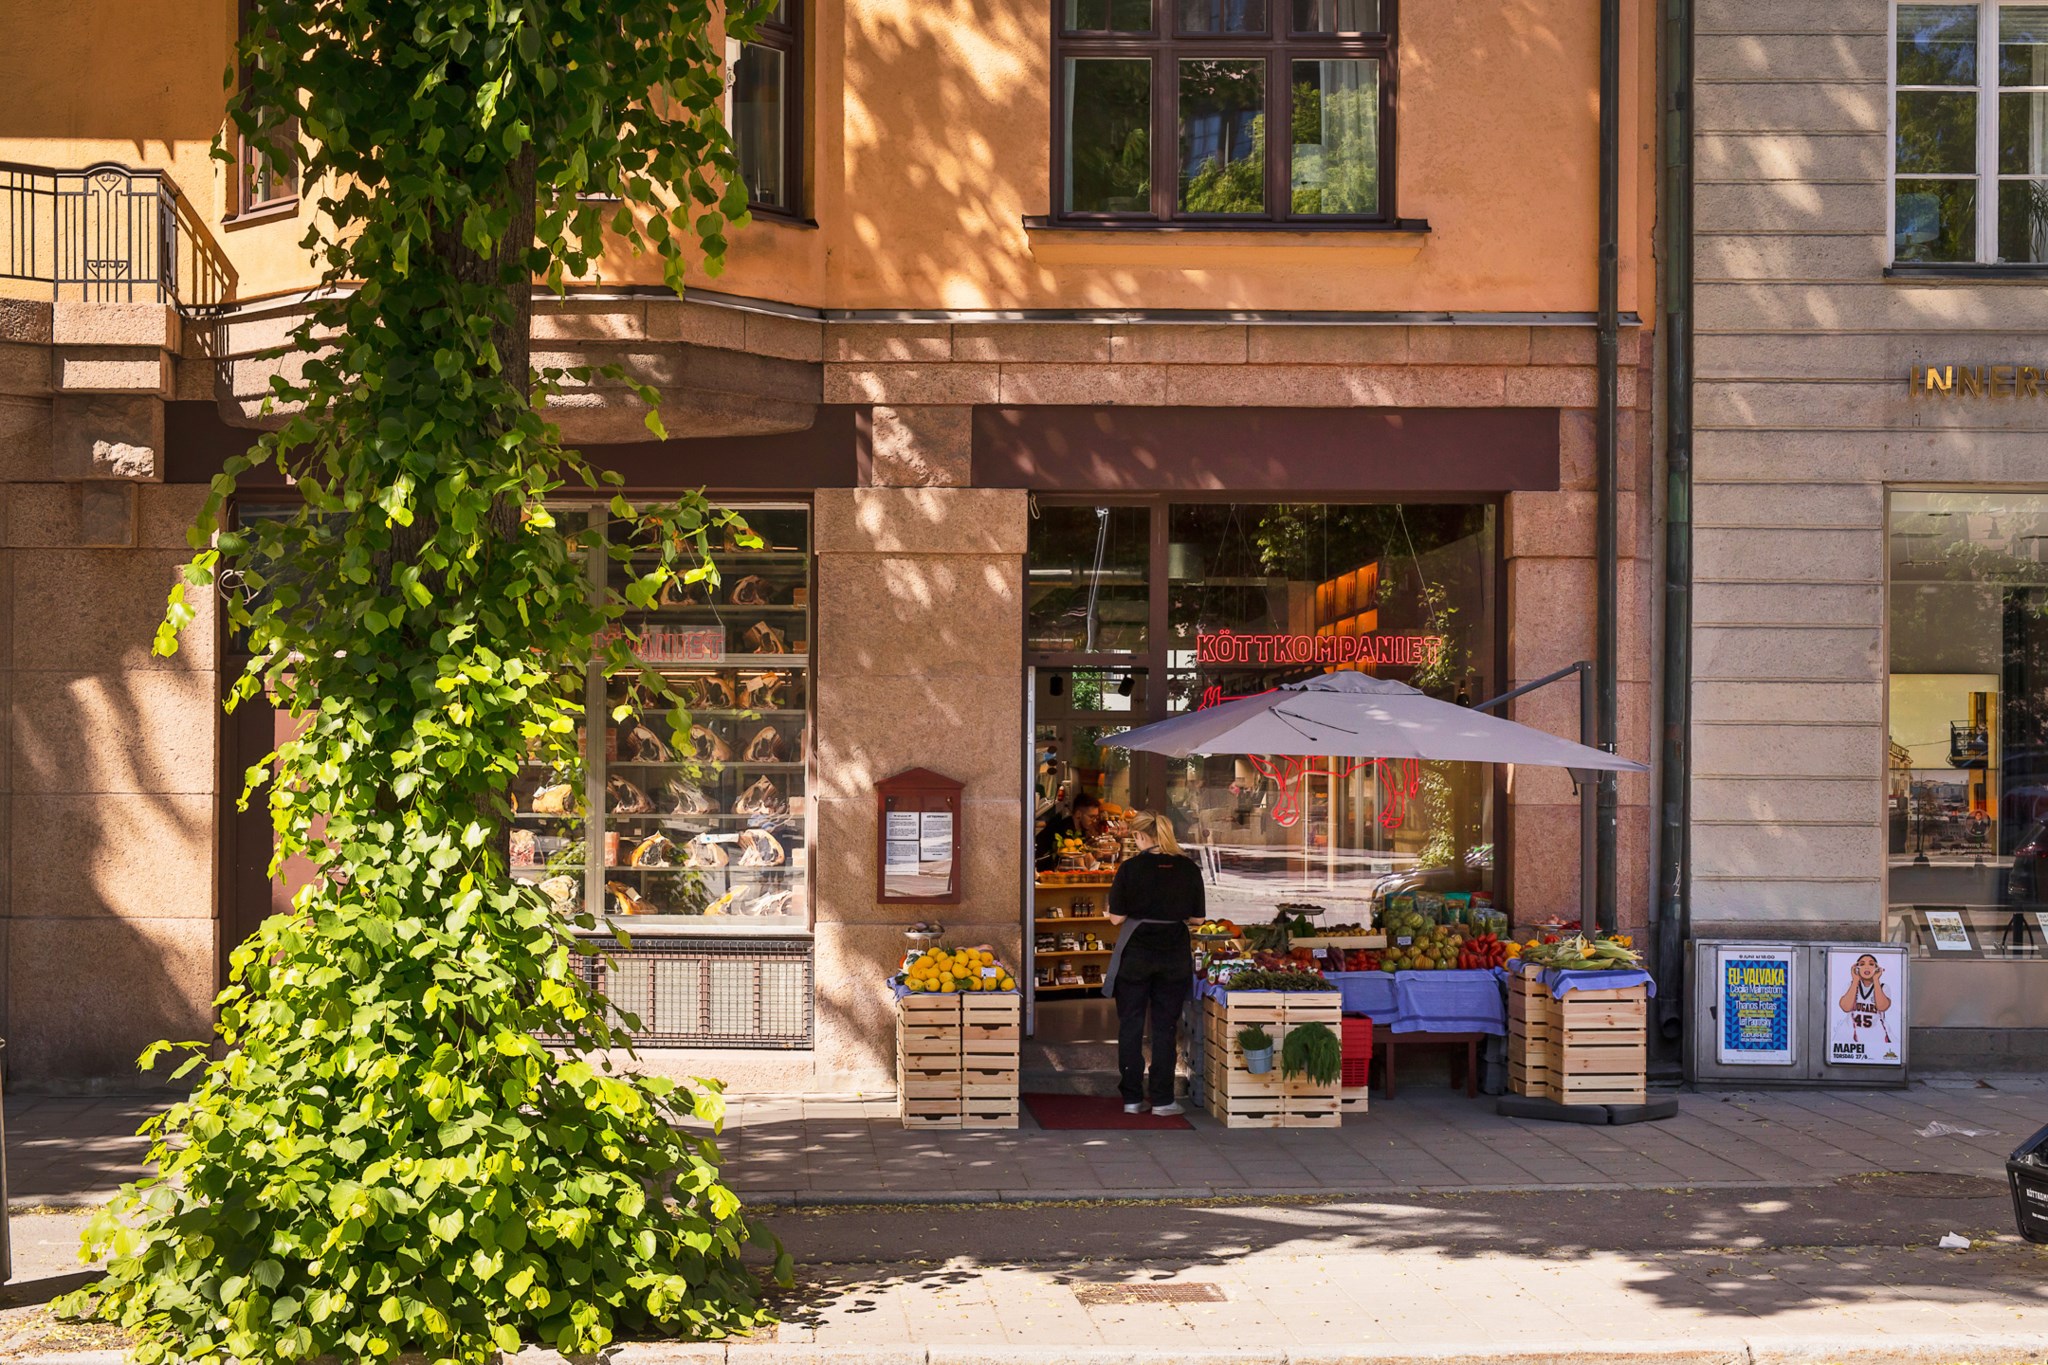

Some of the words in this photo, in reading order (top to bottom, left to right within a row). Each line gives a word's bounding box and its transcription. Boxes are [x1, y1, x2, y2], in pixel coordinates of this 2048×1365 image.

[1910, 364, 2048, 398] INNER
[1197, 629, 1442, 664] KÖTTKOMPANIET
[1728, 968, 1785, 985] EU-VALVAKA
[1854, 1014, 1873, 1028] 45
[1833, 1043, 1865, 1054] MAPEI
